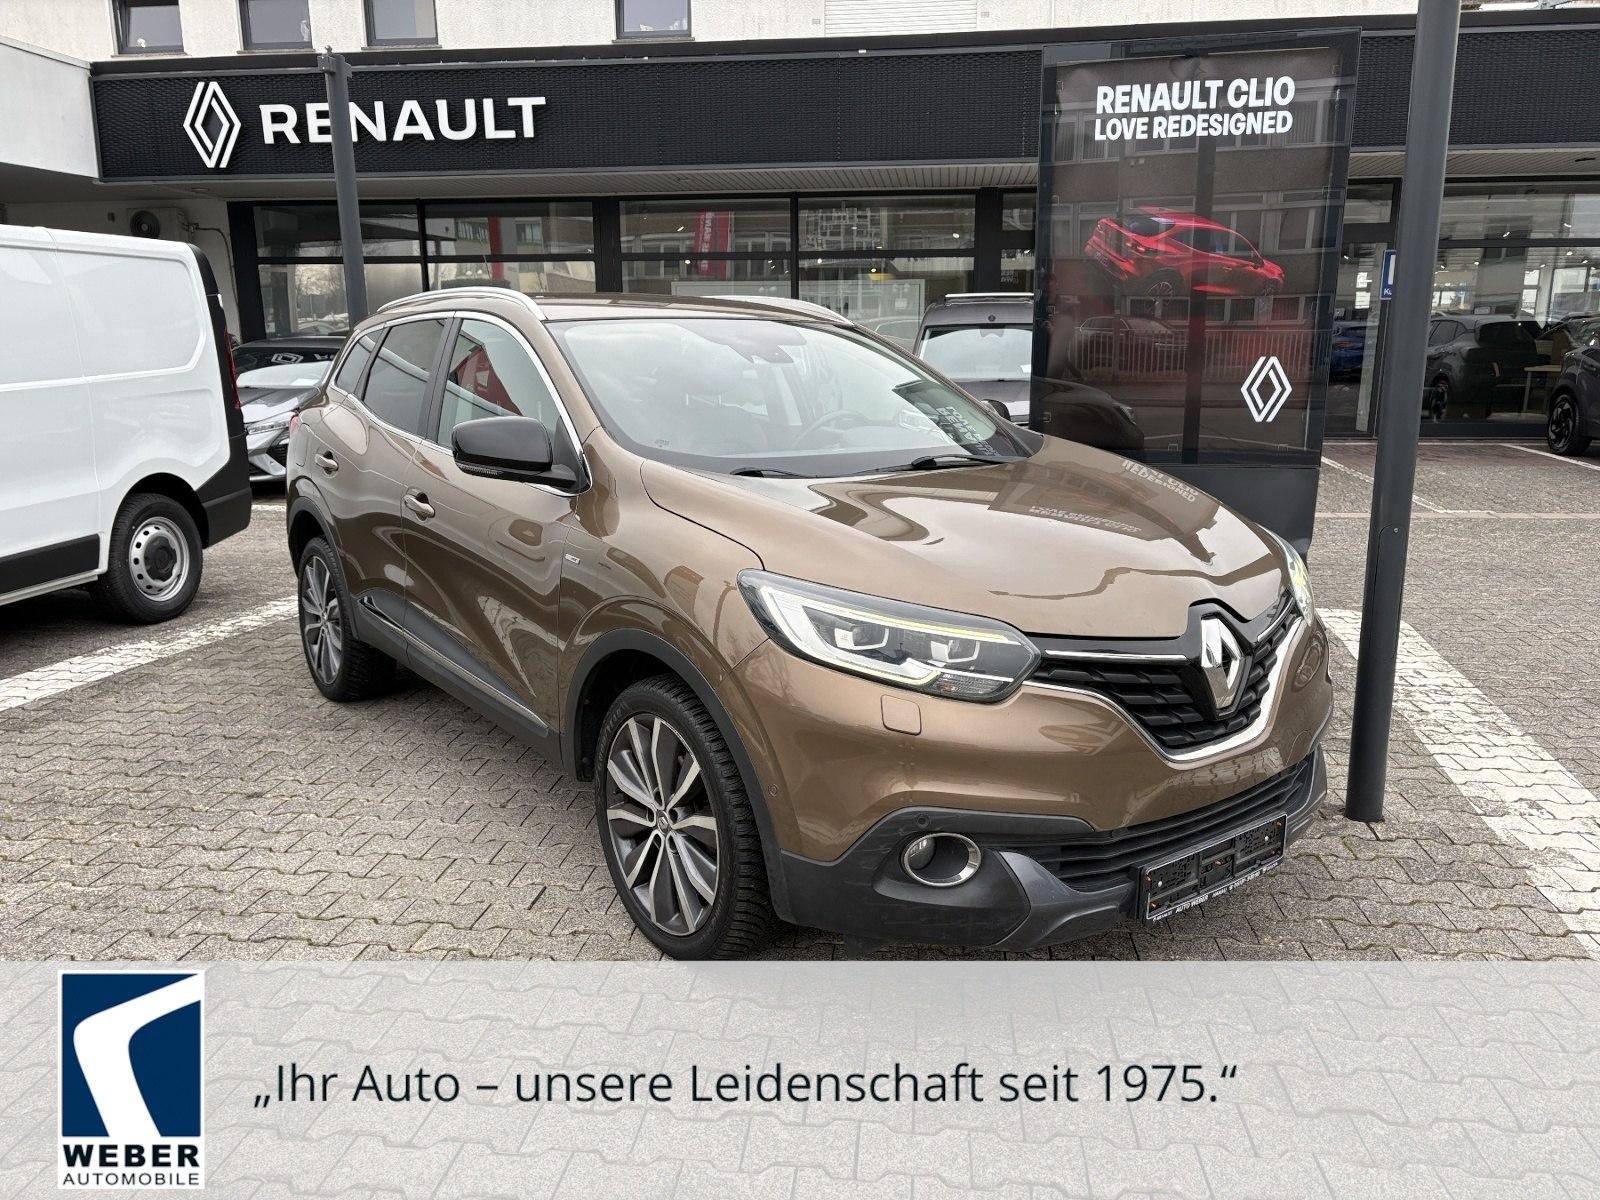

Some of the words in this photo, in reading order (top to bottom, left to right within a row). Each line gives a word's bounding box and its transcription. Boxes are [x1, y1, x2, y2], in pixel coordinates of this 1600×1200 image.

[1096, 80, 1223, 114] RENAULT
[1227, 76, 1295, 108] CLIO
[258, 96, 547, 145] RENAULT
[1094, 117, 1148, 141] LOVE
[1152, 110, 1293, 139] REDESIGNED
